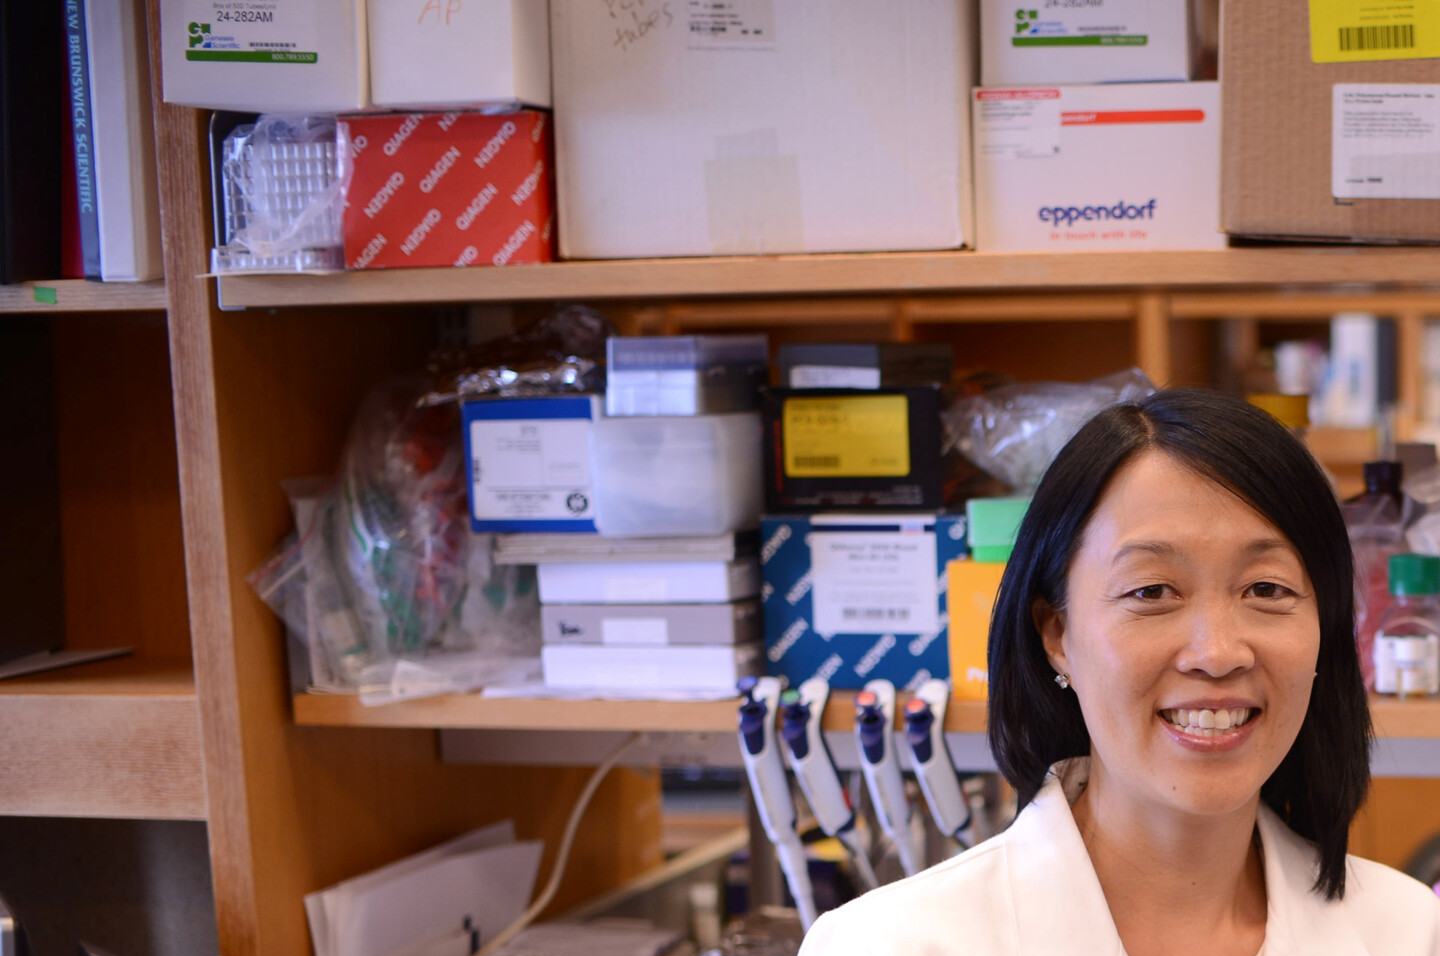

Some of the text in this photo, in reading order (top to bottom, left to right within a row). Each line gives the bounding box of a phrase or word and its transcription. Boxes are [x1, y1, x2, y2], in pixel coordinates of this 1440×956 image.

[217, 11, 273, 22] 24-282AM
[68, 35, 86, 128] BRUNSWICK
[474, 120, 516, 169] QIAGEN
[76, 133, 93, 213] SCIENTIFIC
[419, 146, 461, 194] QIAGEN
[364, 171, 405, 220] QIAGEN
[456, 183, 498, 231] QIAGEN
[1039, 199, 1157, 227] eppendorf
[401, 208, 442, 257] QIAGEN
[492, 220, 536, 268] QIAGEN
